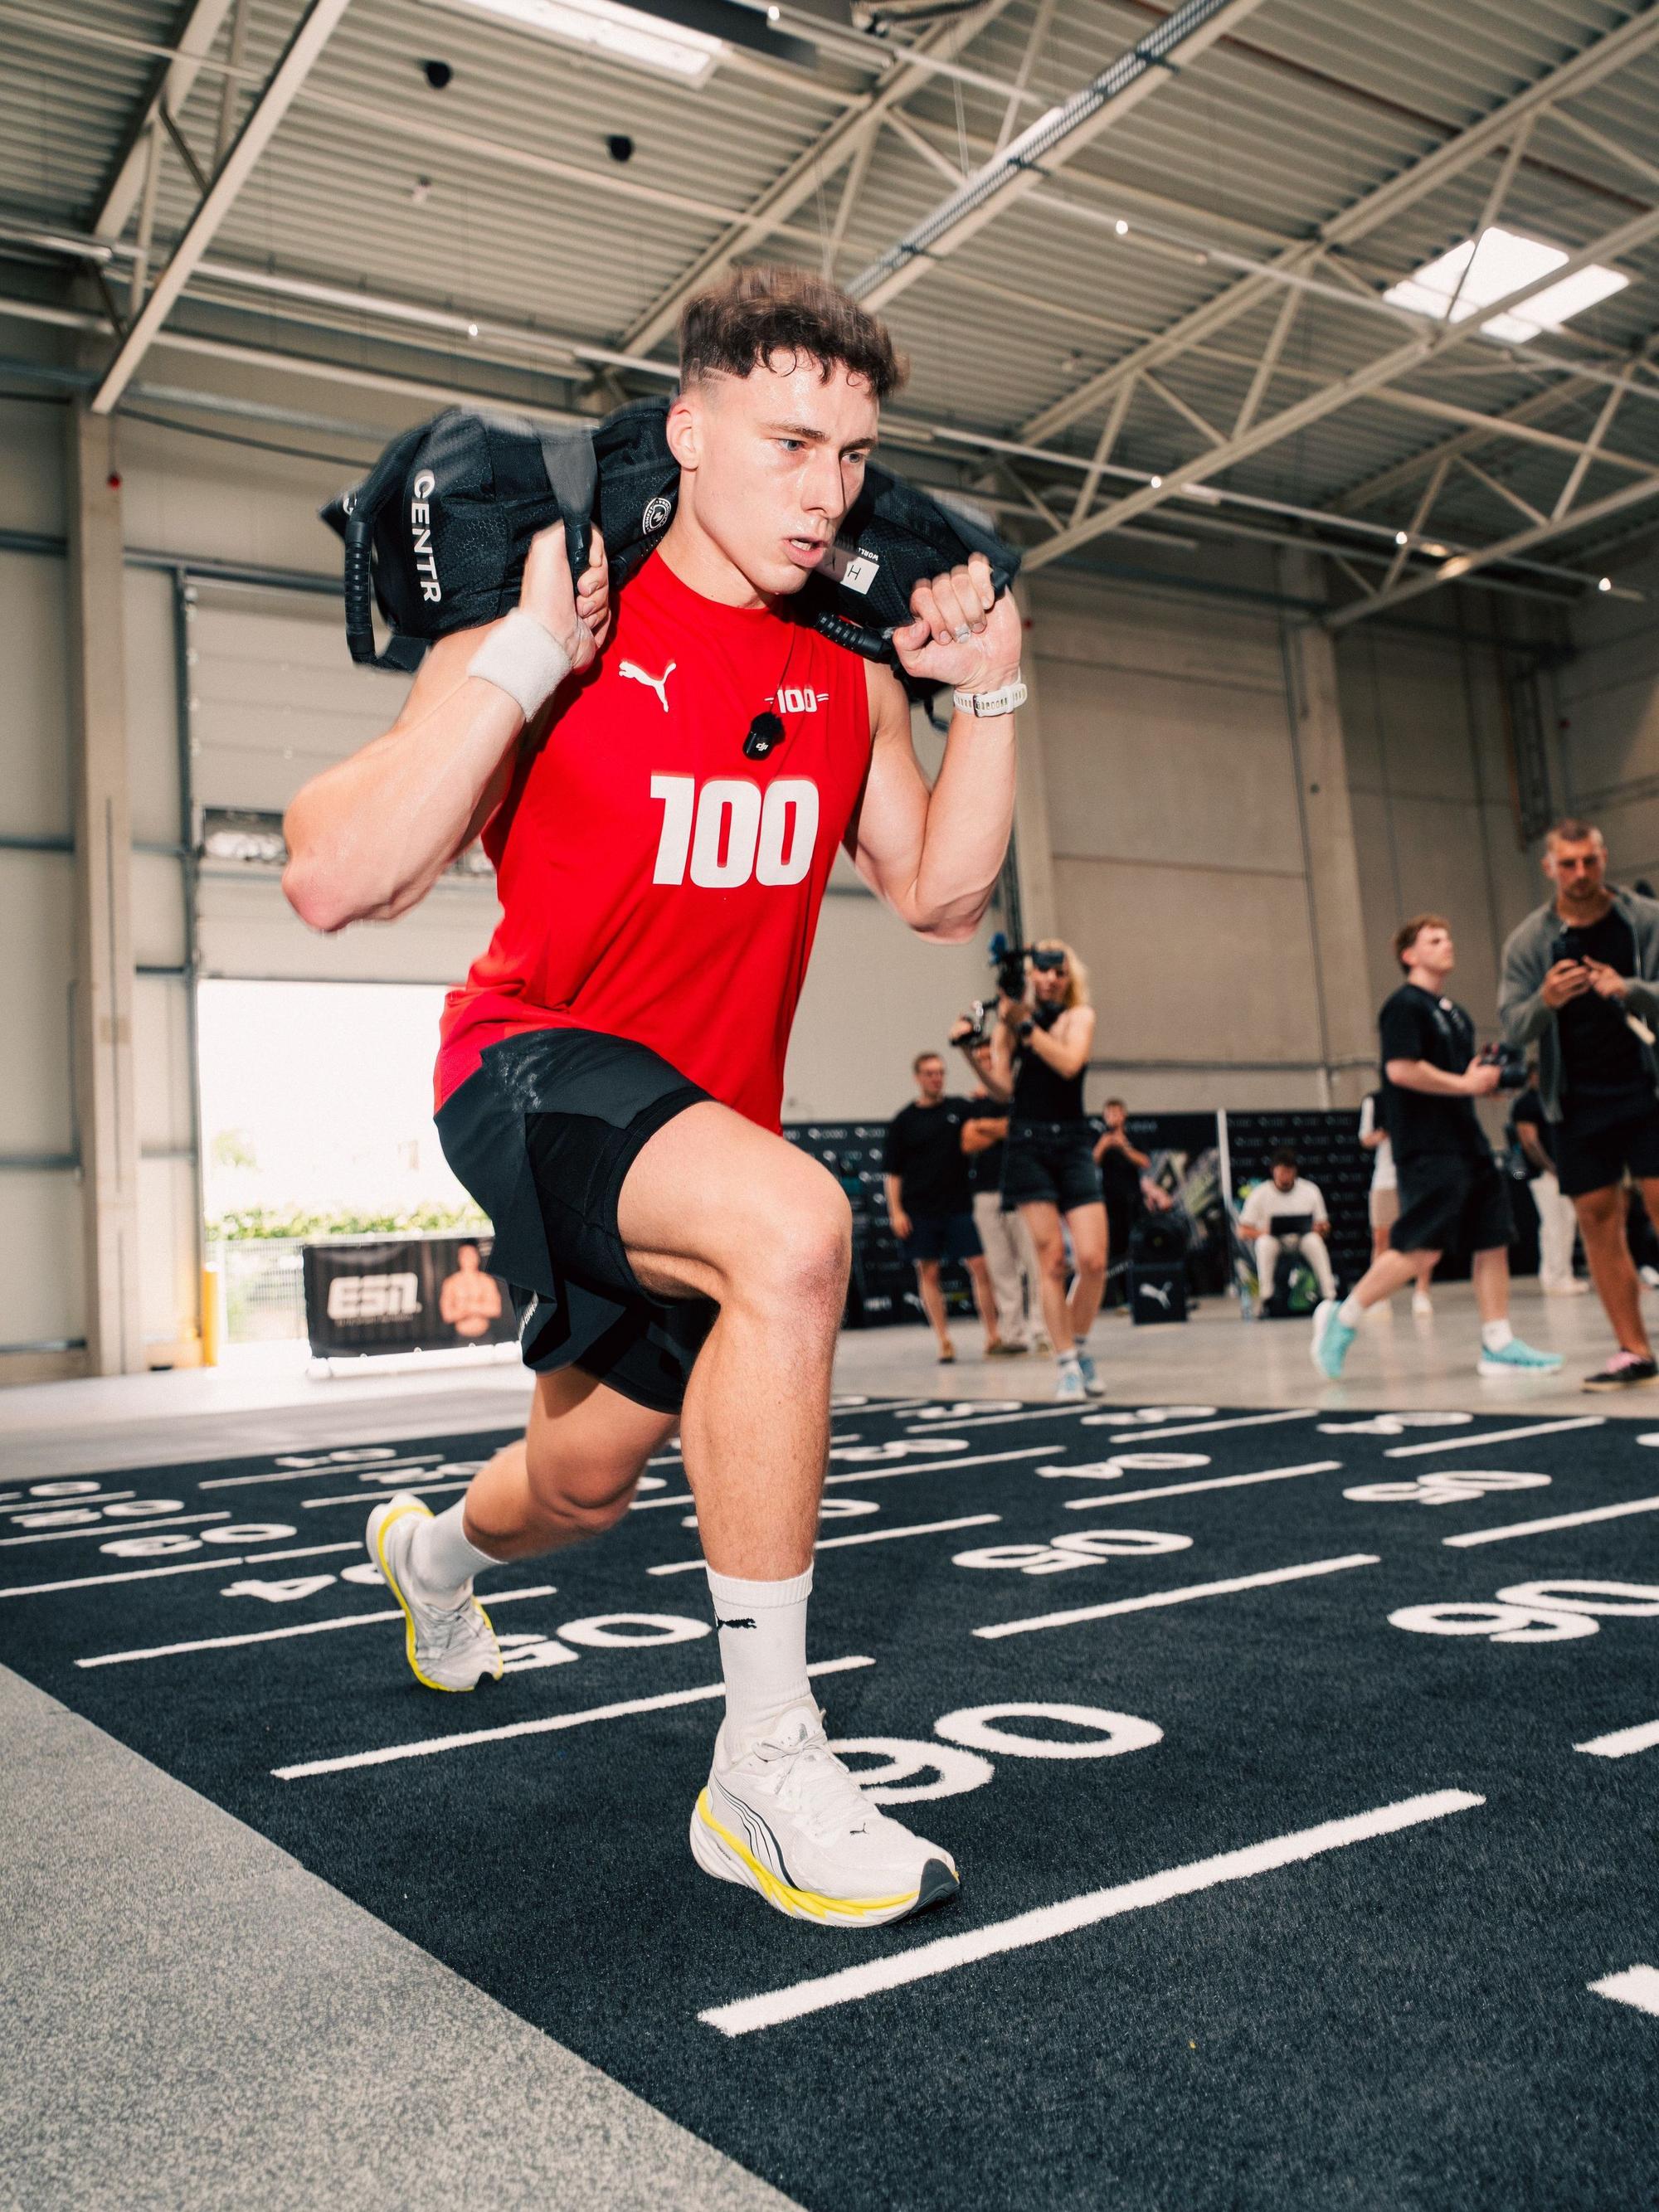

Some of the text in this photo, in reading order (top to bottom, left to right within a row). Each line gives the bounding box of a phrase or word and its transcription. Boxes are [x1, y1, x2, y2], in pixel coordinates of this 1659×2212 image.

[411, 472, 442, 603] CENTR
[776, 686, 818, 713] 100
[650, 772, 820, 888] 100
